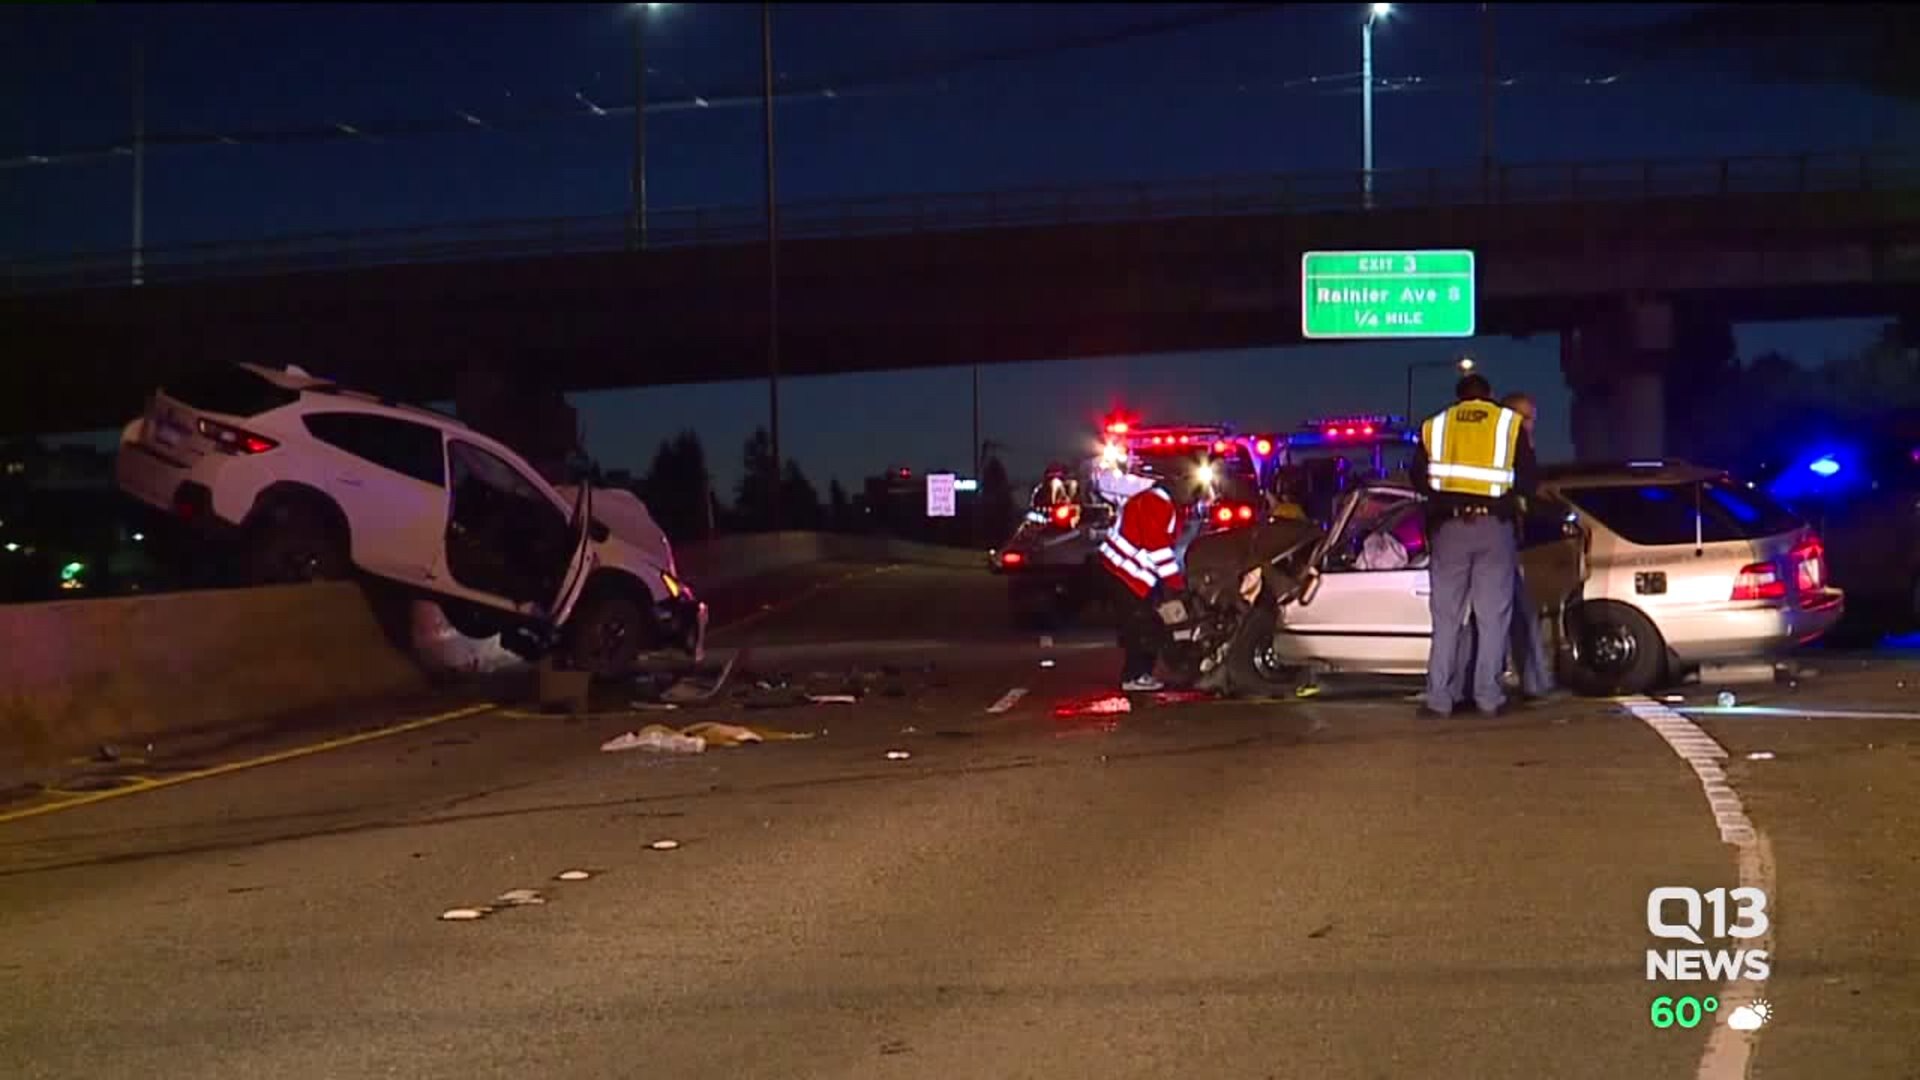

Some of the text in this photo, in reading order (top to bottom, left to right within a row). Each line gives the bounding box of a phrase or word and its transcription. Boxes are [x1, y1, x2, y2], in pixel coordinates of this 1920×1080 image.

[1358, 255, 1417, 273] EXIT 3
[1317, 287, 1390, 304] Rainier
[1400, 287, 1438, 304] Ave
[1384, 311, 1424, 326] MILE
